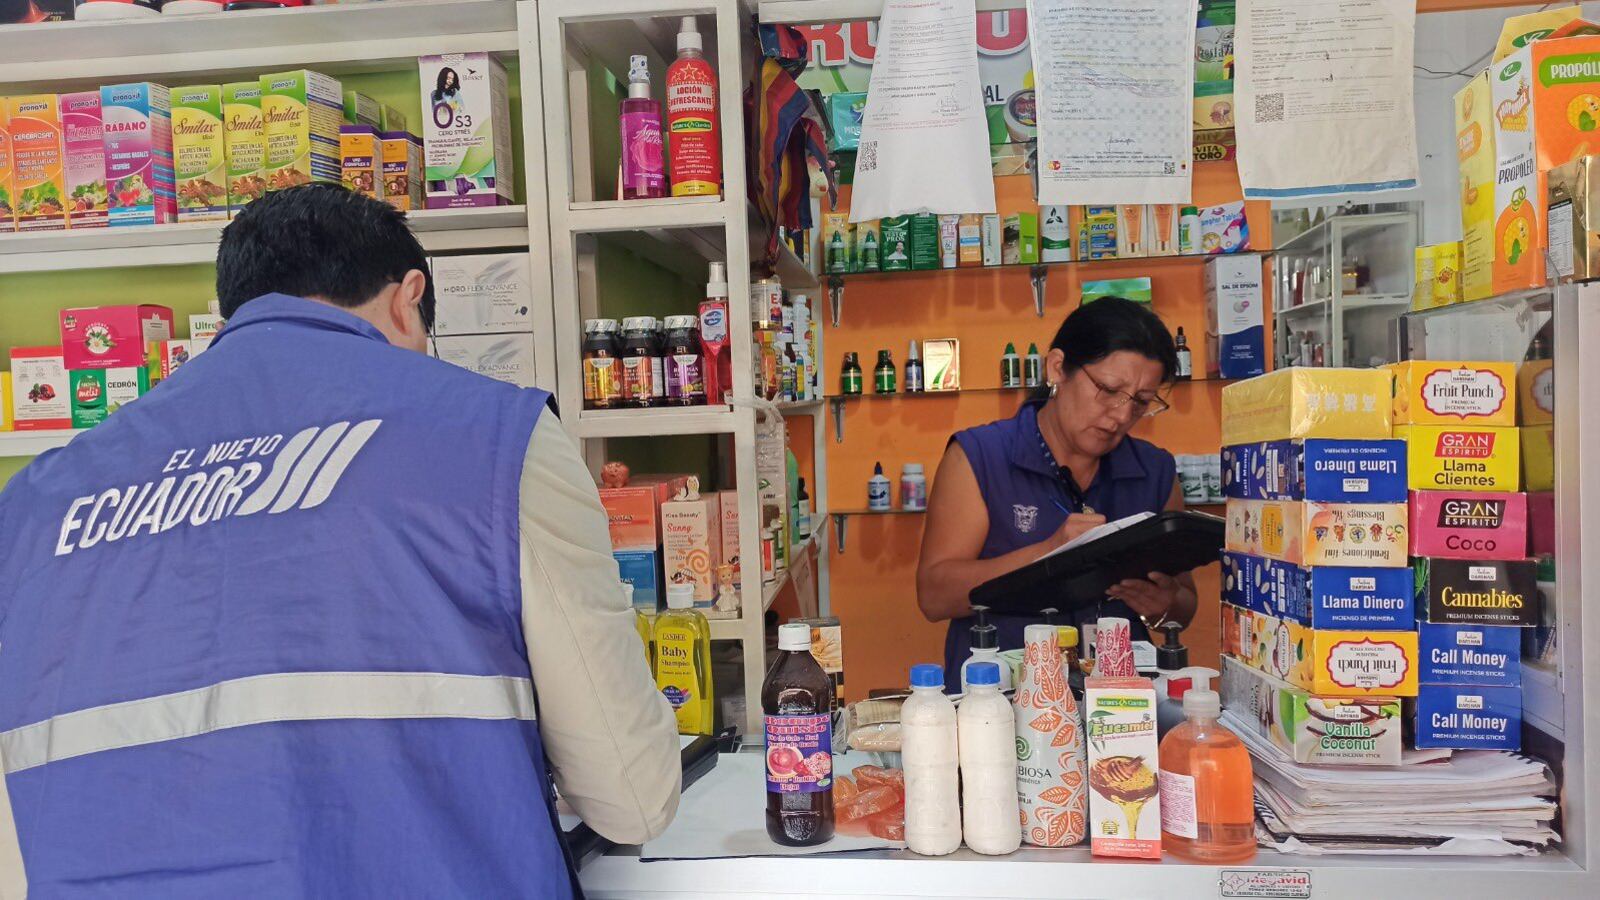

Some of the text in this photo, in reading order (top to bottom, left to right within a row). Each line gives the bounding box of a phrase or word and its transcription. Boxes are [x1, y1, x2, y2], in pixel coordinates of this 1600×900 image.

[676, 84, 702, 95] LOCIÓN
[113, 92, 141, 102] pronavit
[182, 93, 210, 102] pronavit
[19, 103, 48, 113] pronavit
[263, 107, 304, 124] Smilax
[174, 117, 217, 135] Smilax
[1499, 158, 1534, 184] PROPOLEO
[1091, 223, 1115, 231] PAICO
[485, 283, 518, 291] ADVANCE
[107, 380, 137, 389] CEDRÓN
[1433, 383, 1494, 399] Fruit Punch
[1442, 434, 1488, 447] GRAN
[162, 434, 283, 473] EL NUEVO
[1441, 448, 1489, 456] ESPIRITU
[1315, 460, 1397, 474] Llama Dinero
[1443, 460, 1486, 473] Llama
[1434, 473, 1495, 487] Clientes
[55, 462, 262, 556] ECUADOR
[1347, 509, 1385, 521] Blessings
[1445, 501, 1498, 516] GRAN
[667, 523, 692, 533] Sunny
[1445, 518, 1498, 527] ESPIRITU
[1446, 535, 1496, 551] Coco
[1322, 595, 1404, 610] Llama Dinero
[1441, 586, 1523, 609] Cannabies
[662, 646, 688, 660] Baby
[1432, 648, 1506, 668] Call Money
[1338, 659, 1397, 674] Fruit Punch
[1092, 720, 1154, 737] Eucamiel
[1432, 712, 1507, 732] Call Money
[1325, 723, 1370, 737] Vanilla
[1321, 737, 1376, 750] Coconut
[1017, 763, 1052, 779] BIOSA
